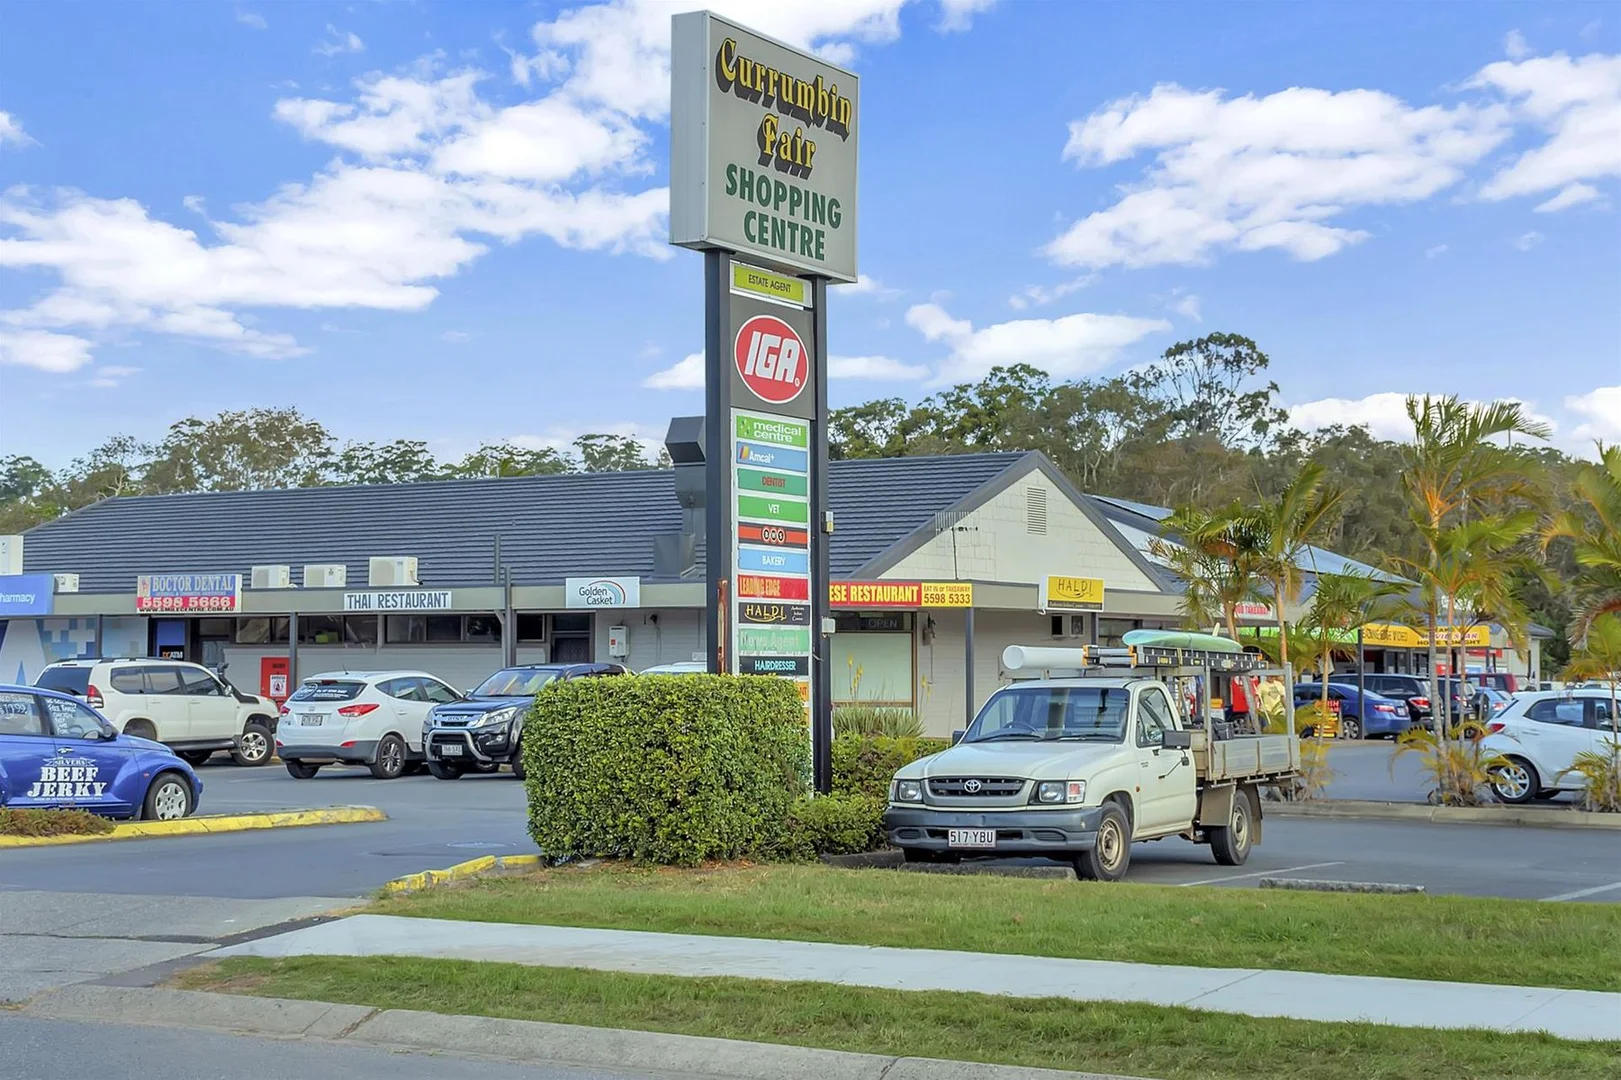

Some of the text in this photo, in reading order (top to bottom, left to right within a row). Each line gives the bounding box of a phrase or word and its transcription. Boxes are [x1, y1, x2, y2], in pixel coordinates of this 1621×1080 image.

[716, 38, 852, 140] Currumbin
[757, 113, 817, 179] Fair
[725, 163, 842, 229] SHOPPING
[743, 210, 825, 261] CENTRE
[748, 274, 791, 293] ESTATE AGENT
[744, 330, 801, 383] IGA
[753, 421, 802, 436] medical
[753, 430, 793, 443] centre
[768, 504, 780, 514] VET
[762, 555, 786, 566] BAKERY
[194, 575, 234, 591] DENTAL
[765, 579, 780, 597] EDGE
[1058, 579, 1092, 592] HALDI
[0, 592, 36, 605] harmacy
[578, 586, 607, 597] Golden
[829, 585, 919, 602] ESE RESTAURANT
[923, 593, 971, 604] 5598 5333
[142, 596, 231, 608] 5598 5666
[347, 592, 449, 609] THAI RESTAURANT
[586, 595, 613, 605] Casket
[746, 604, 784, 617] HALDI
[868, 619, 898, 628] OPEN
[754, 659, 797, 672] HAIRDRESSER
[40, 766, 99, 782] BEEF
[26, 782, 108, 797] JERKY
